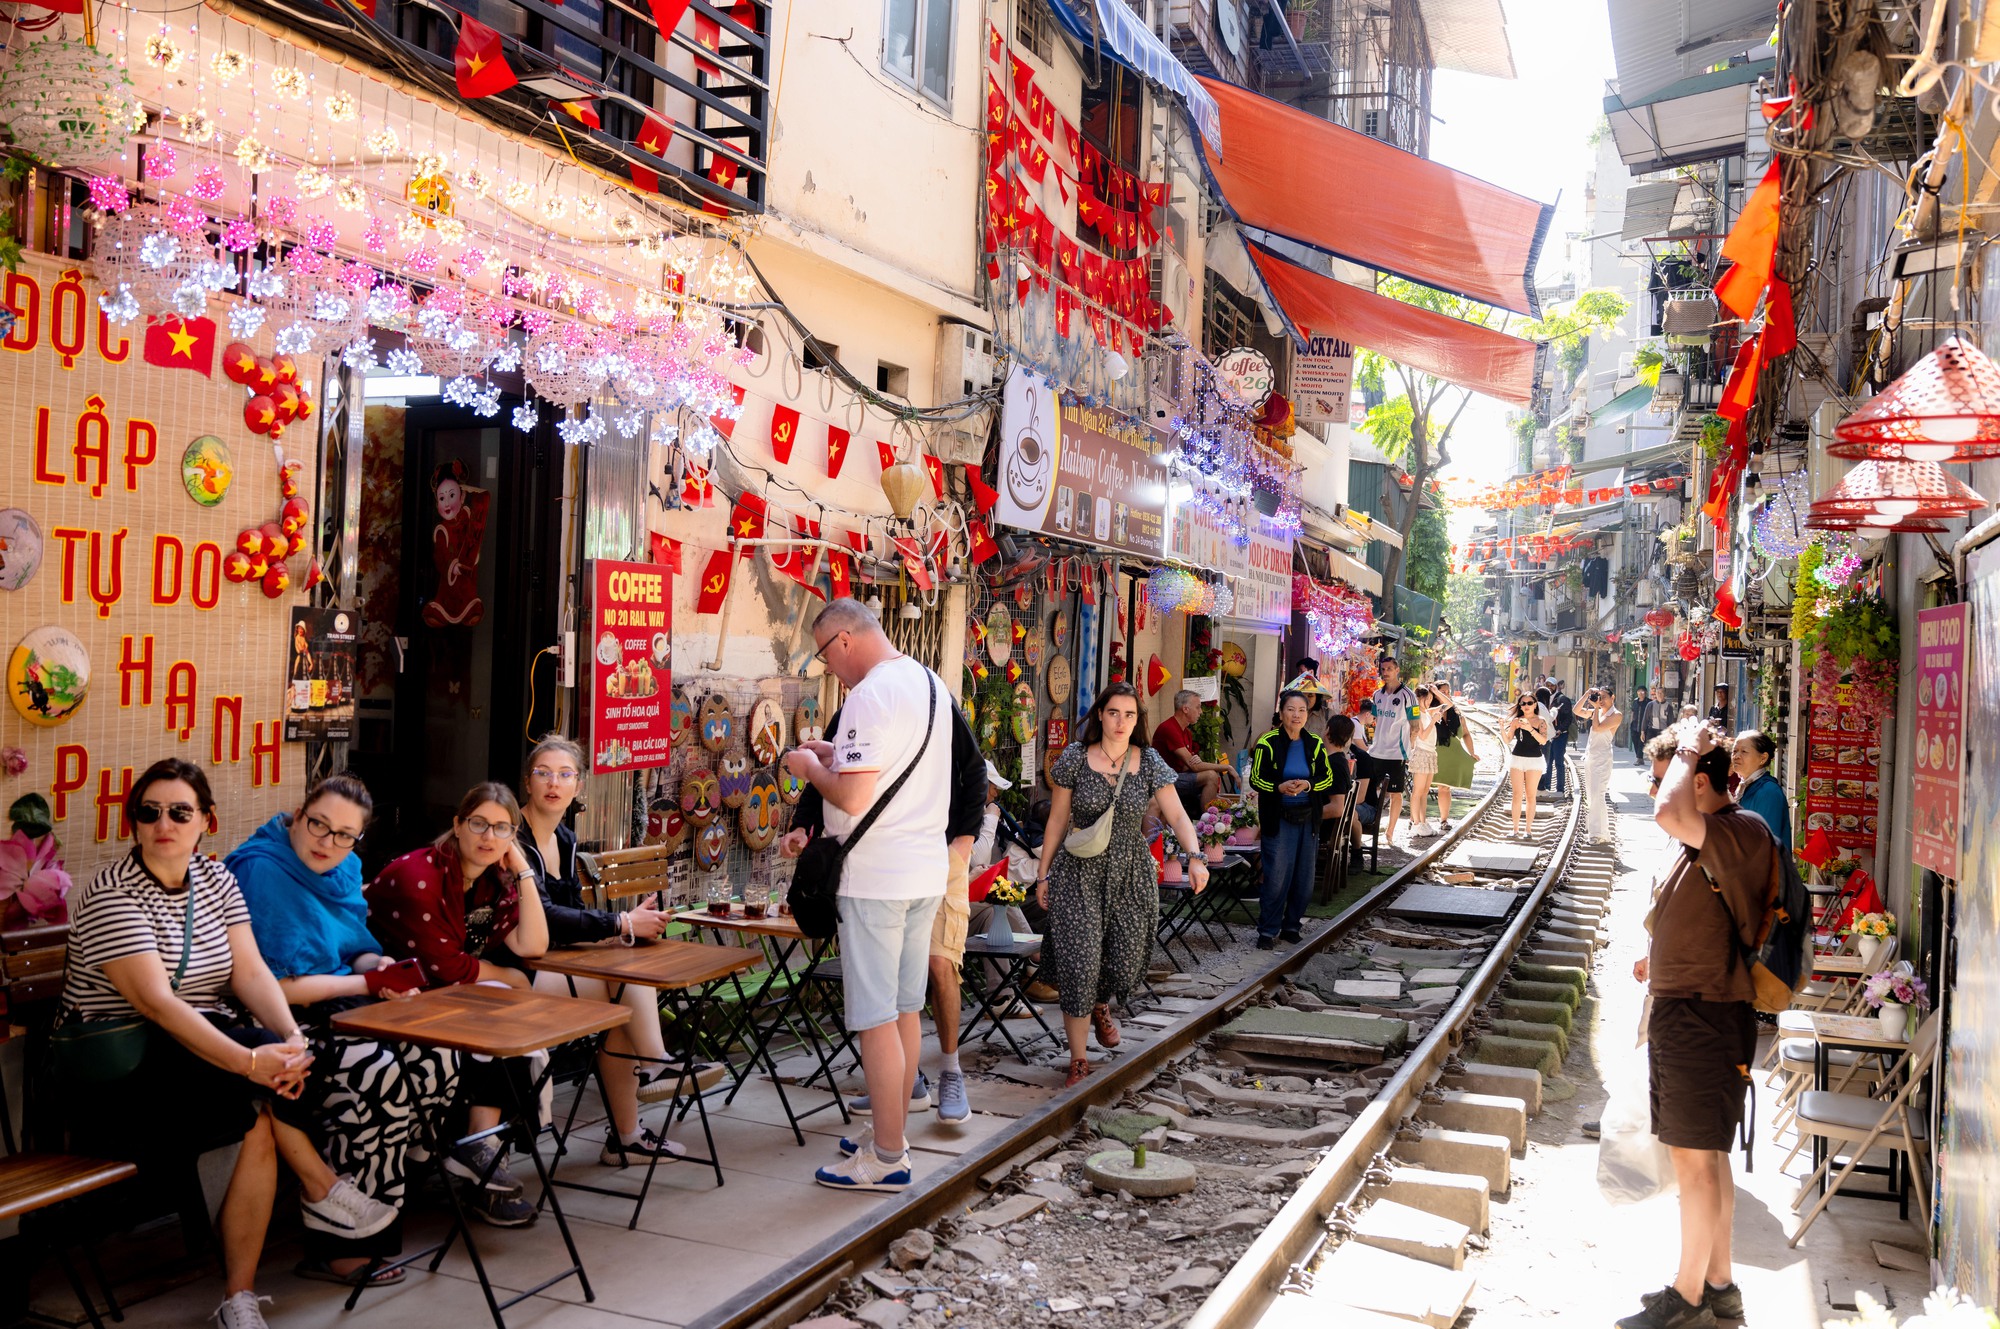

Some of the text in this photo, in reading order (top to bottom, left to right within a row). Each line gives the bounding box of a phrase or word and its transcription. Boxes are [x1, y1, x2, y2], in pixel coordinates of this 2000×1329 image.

[1, 267, 131, 370] ĐỘC
[1222, 357, 1264, 376] Coffee
[1242, 376, 1267, 390] 26
[33, 393, 158, 500] LẬP
[1059, 433, 1096, 493] Railway
[1098, 448, 1124, 499] Coffee
[1263, 545, 1270, 570] &
[1270, 547, 1292, 576] DRINK
[52, 527, 222, 620] TỰ DO
[1264, 573, 1286, 588] DELICIOUS
[608, 570, 662, 604] COFFEE
[1244, 584, 1256, 599] coffee
[1238, 600, 1254, 616] Cocktail
[618, 609, 628, 626] 20
[630, 610, 647, 627] RAIL
[648, 611, 665, 627] WAY
[1920, 617, 1960, 649] MENU FOOD
[624, 638, 648, 650] COFFEE
[1054, 666, 1066, 680] EGG
[117, 634, 282, 787] HẠNH
[605, 701, 660, 720] SINH TỐ HOA QUẢ
[616, 722, 650, 731] FRUIT SMOOTHIE
[632, 736, 668, 751] BIA CÁC LOẠI
[633, 755, 643, 763] BEER
[643, 754, 649, 762] OF
